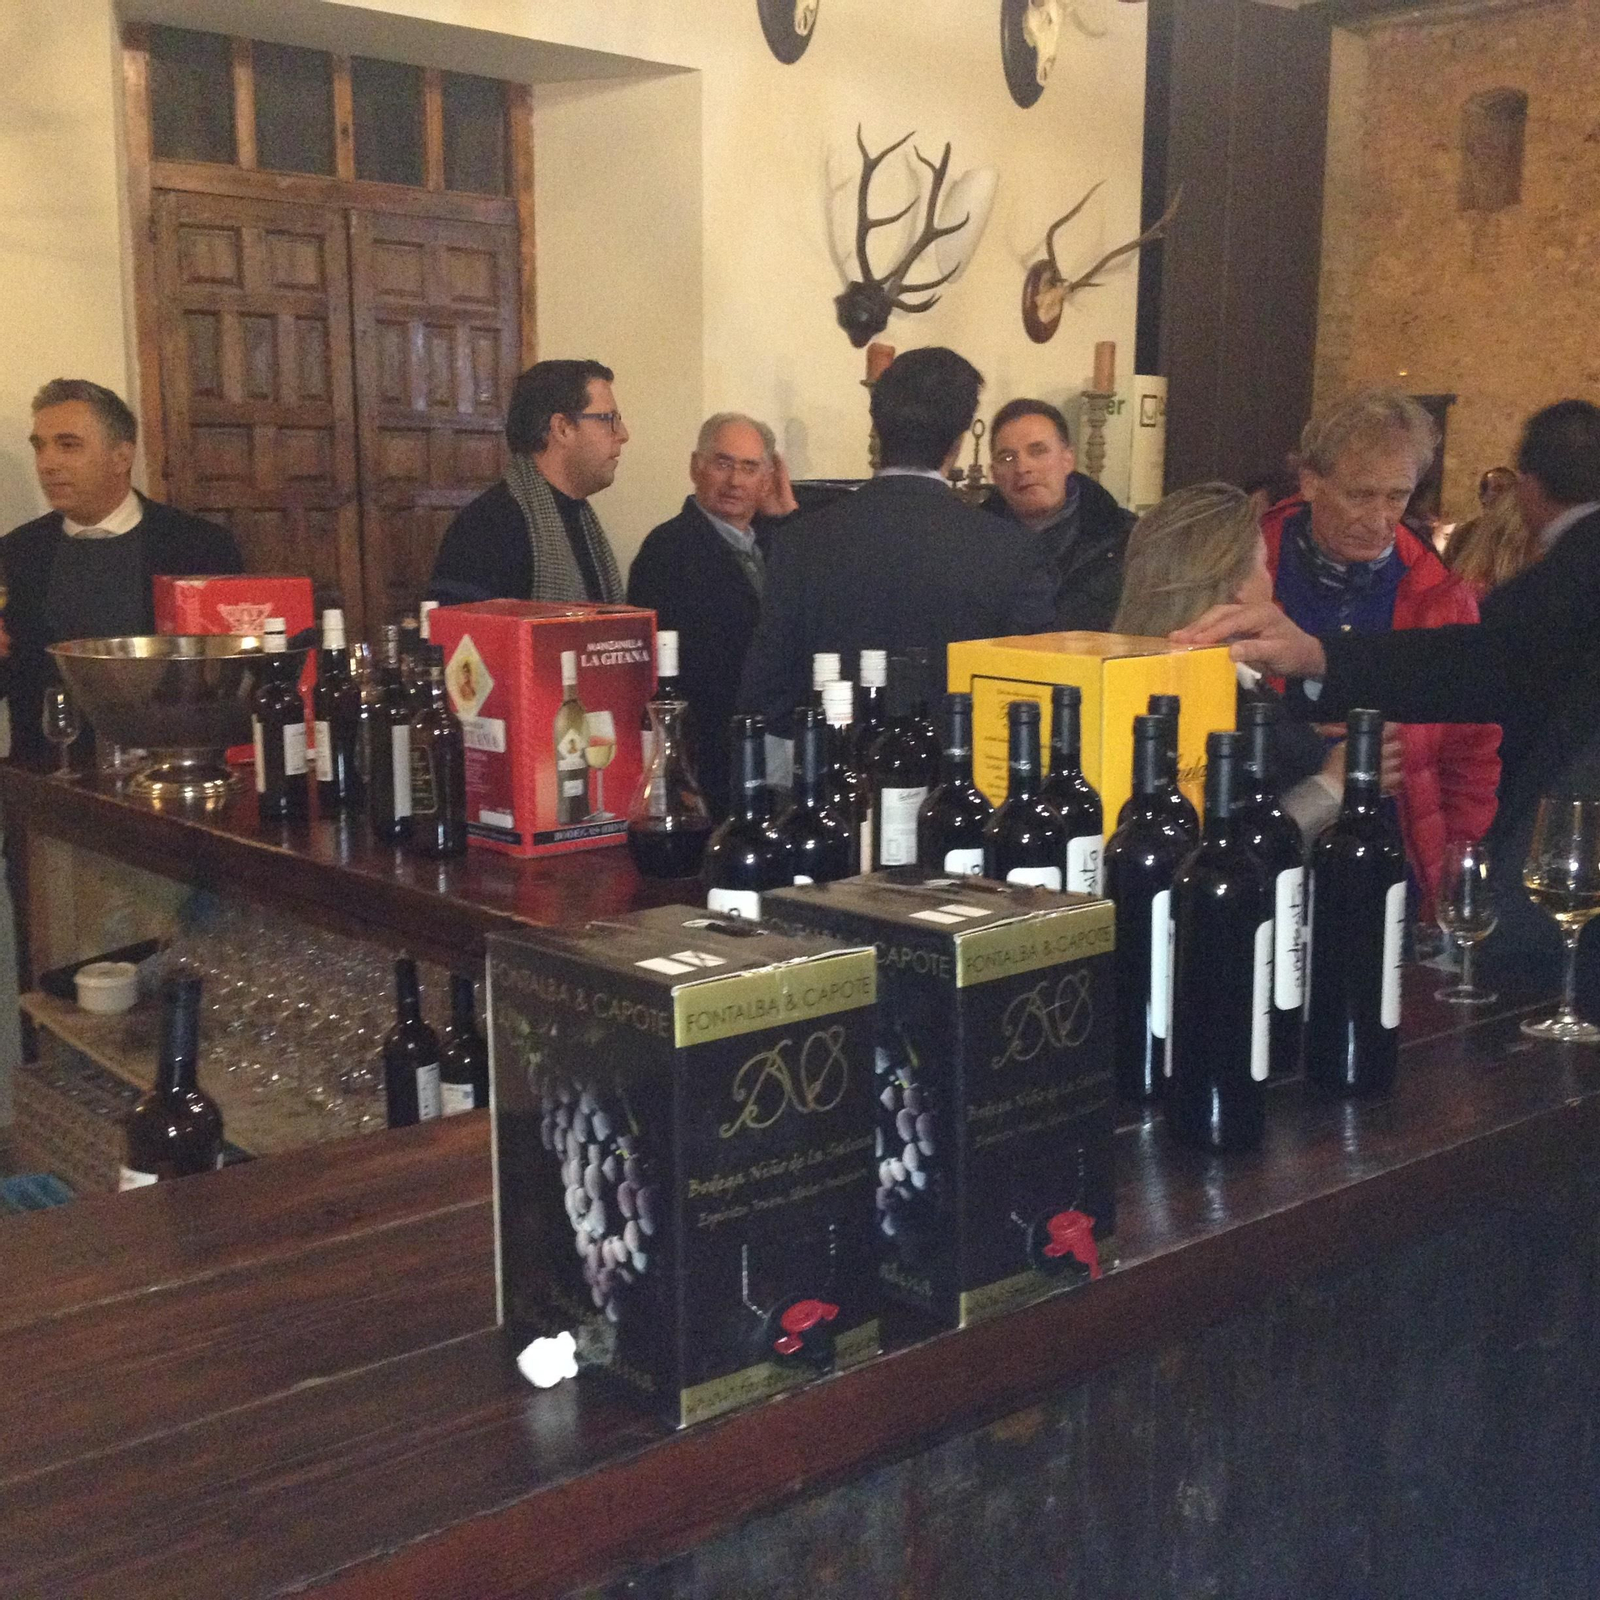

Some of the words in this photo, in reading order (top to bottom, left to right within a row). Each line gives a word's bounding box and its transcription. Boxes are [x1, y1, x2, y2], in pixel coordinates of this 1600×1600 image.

[580, 654, 600, 667] LA
[601, 650, 651, 666] GITANA
[586, 639, 644, 652] MANZANILLA
[875, 941, 952, 979] CAPOTE
[967, 946, 1036, 974] FONTALBA
[1042, 938, 1053, 957] &
[1053, 928, 1112, 953] CAPOTE
[593, 992, 672, 1038] CAPOTE
[686, 997, 780, 1033] FONTALBA
[785, 993, 798, 1012] &
[802, 975, 872, 1008] CAPOTE
